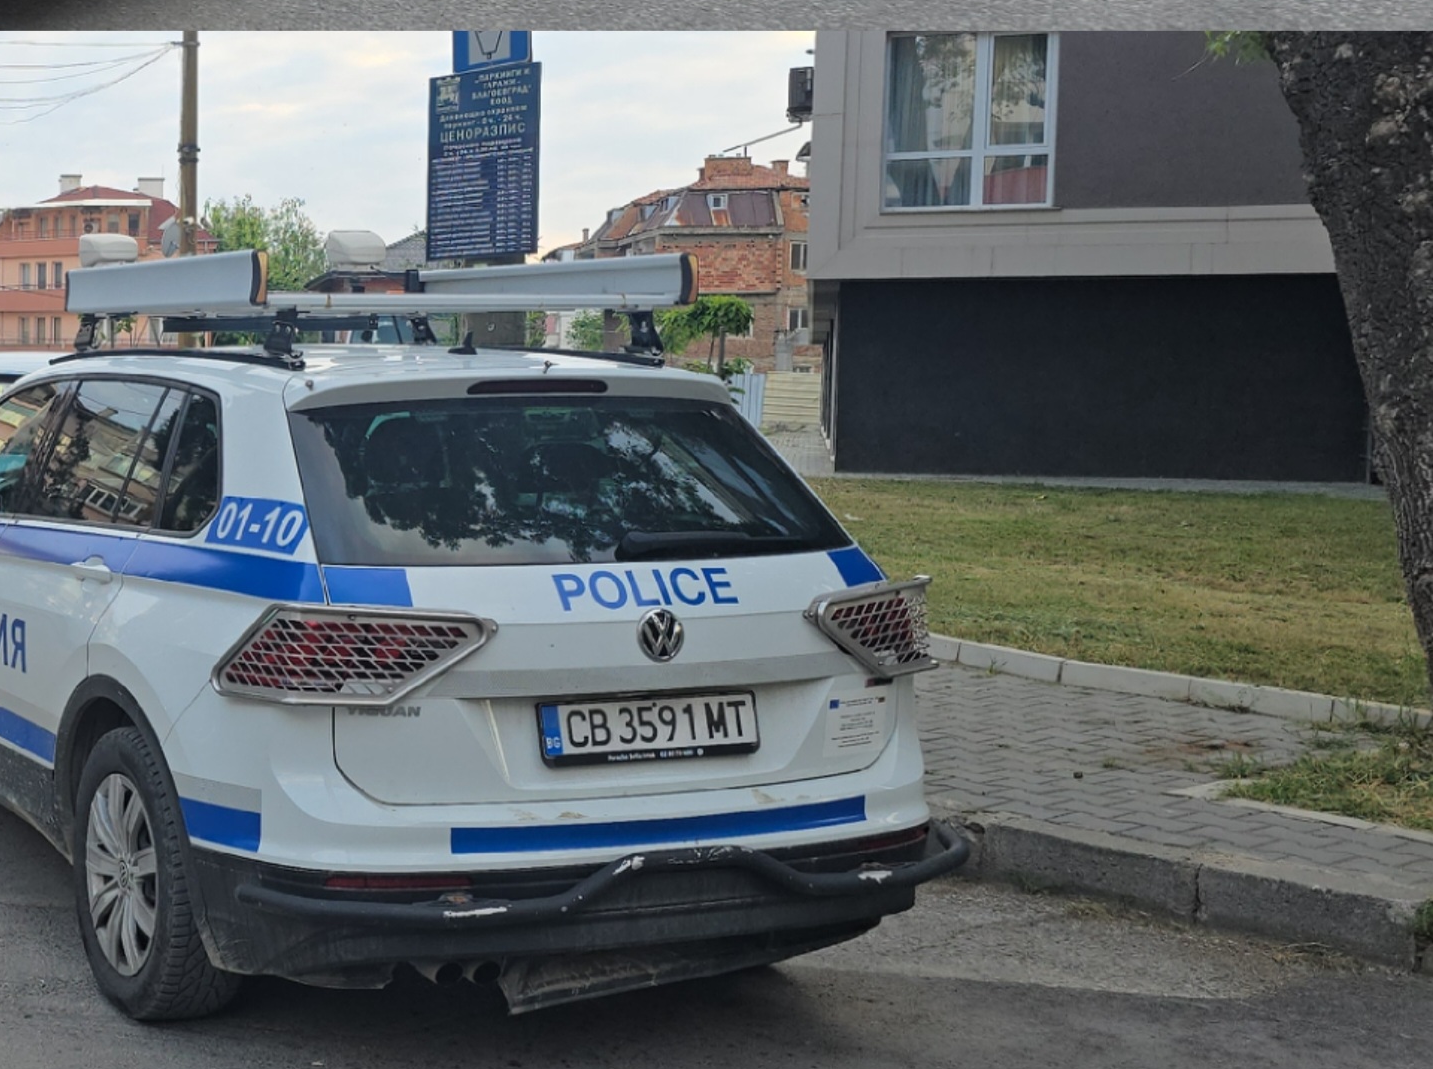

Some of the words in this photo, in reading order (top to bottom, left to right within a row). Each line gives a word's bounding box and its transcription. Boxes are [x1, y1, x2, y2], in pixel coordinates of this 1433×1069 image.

[440, 122, 526, 143] ЦЕНОРАЗПИС
[216, 502, 303, 547] 01-10
[551, 567, 739, 611] POLICE
[546, 737, 561, 749] BG
[618, 704, 696, 744] 3591
